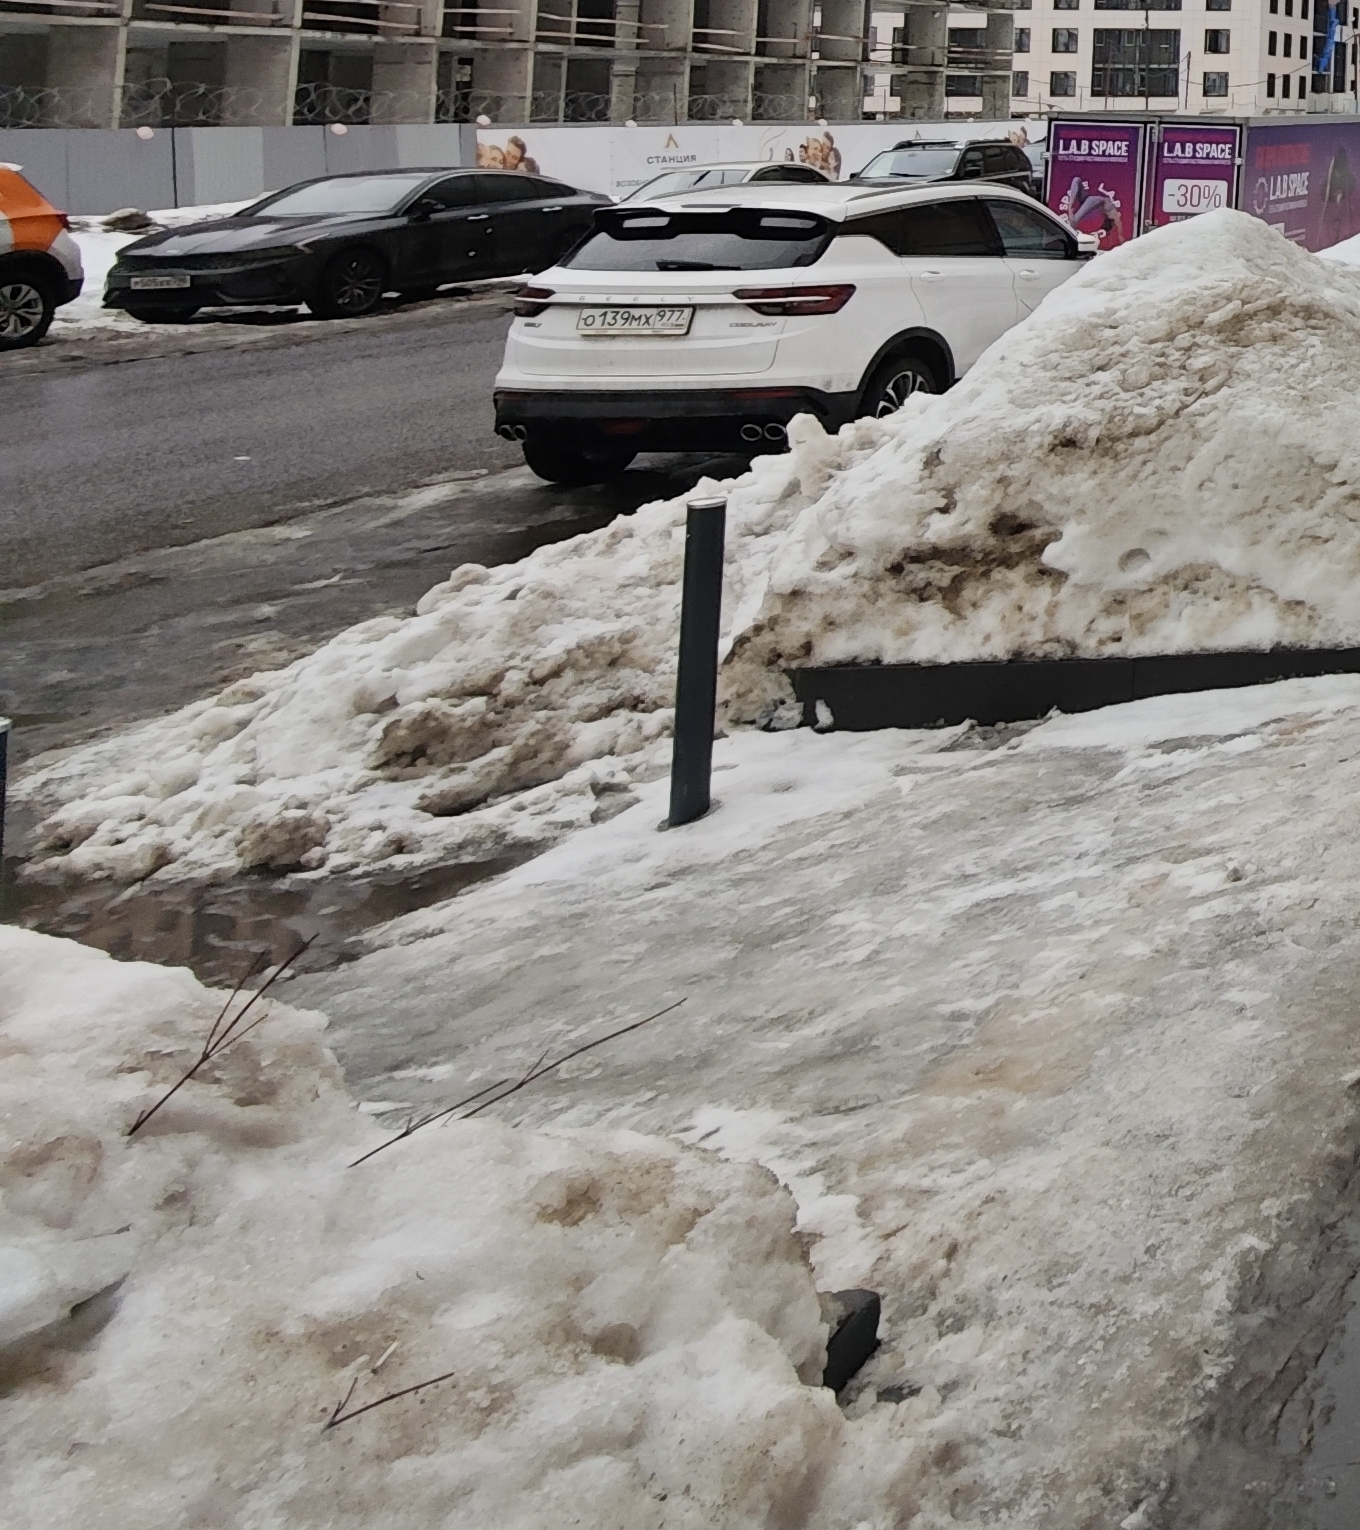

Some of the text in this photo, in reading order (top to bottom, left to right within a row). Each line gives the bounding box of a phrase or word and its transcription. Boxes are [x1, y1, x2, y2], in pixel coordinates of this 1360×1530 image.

[1091, 140, 1130, 156] SPACE
[1195, 142, 1233, 159] SPACE
[646, 154, 697, 165] СТАНЦИЯ
[1167, 183, 1222, 209] -30%
[578, 295, 696, 303] GEELY
[656, 309, 685, 323] 977
